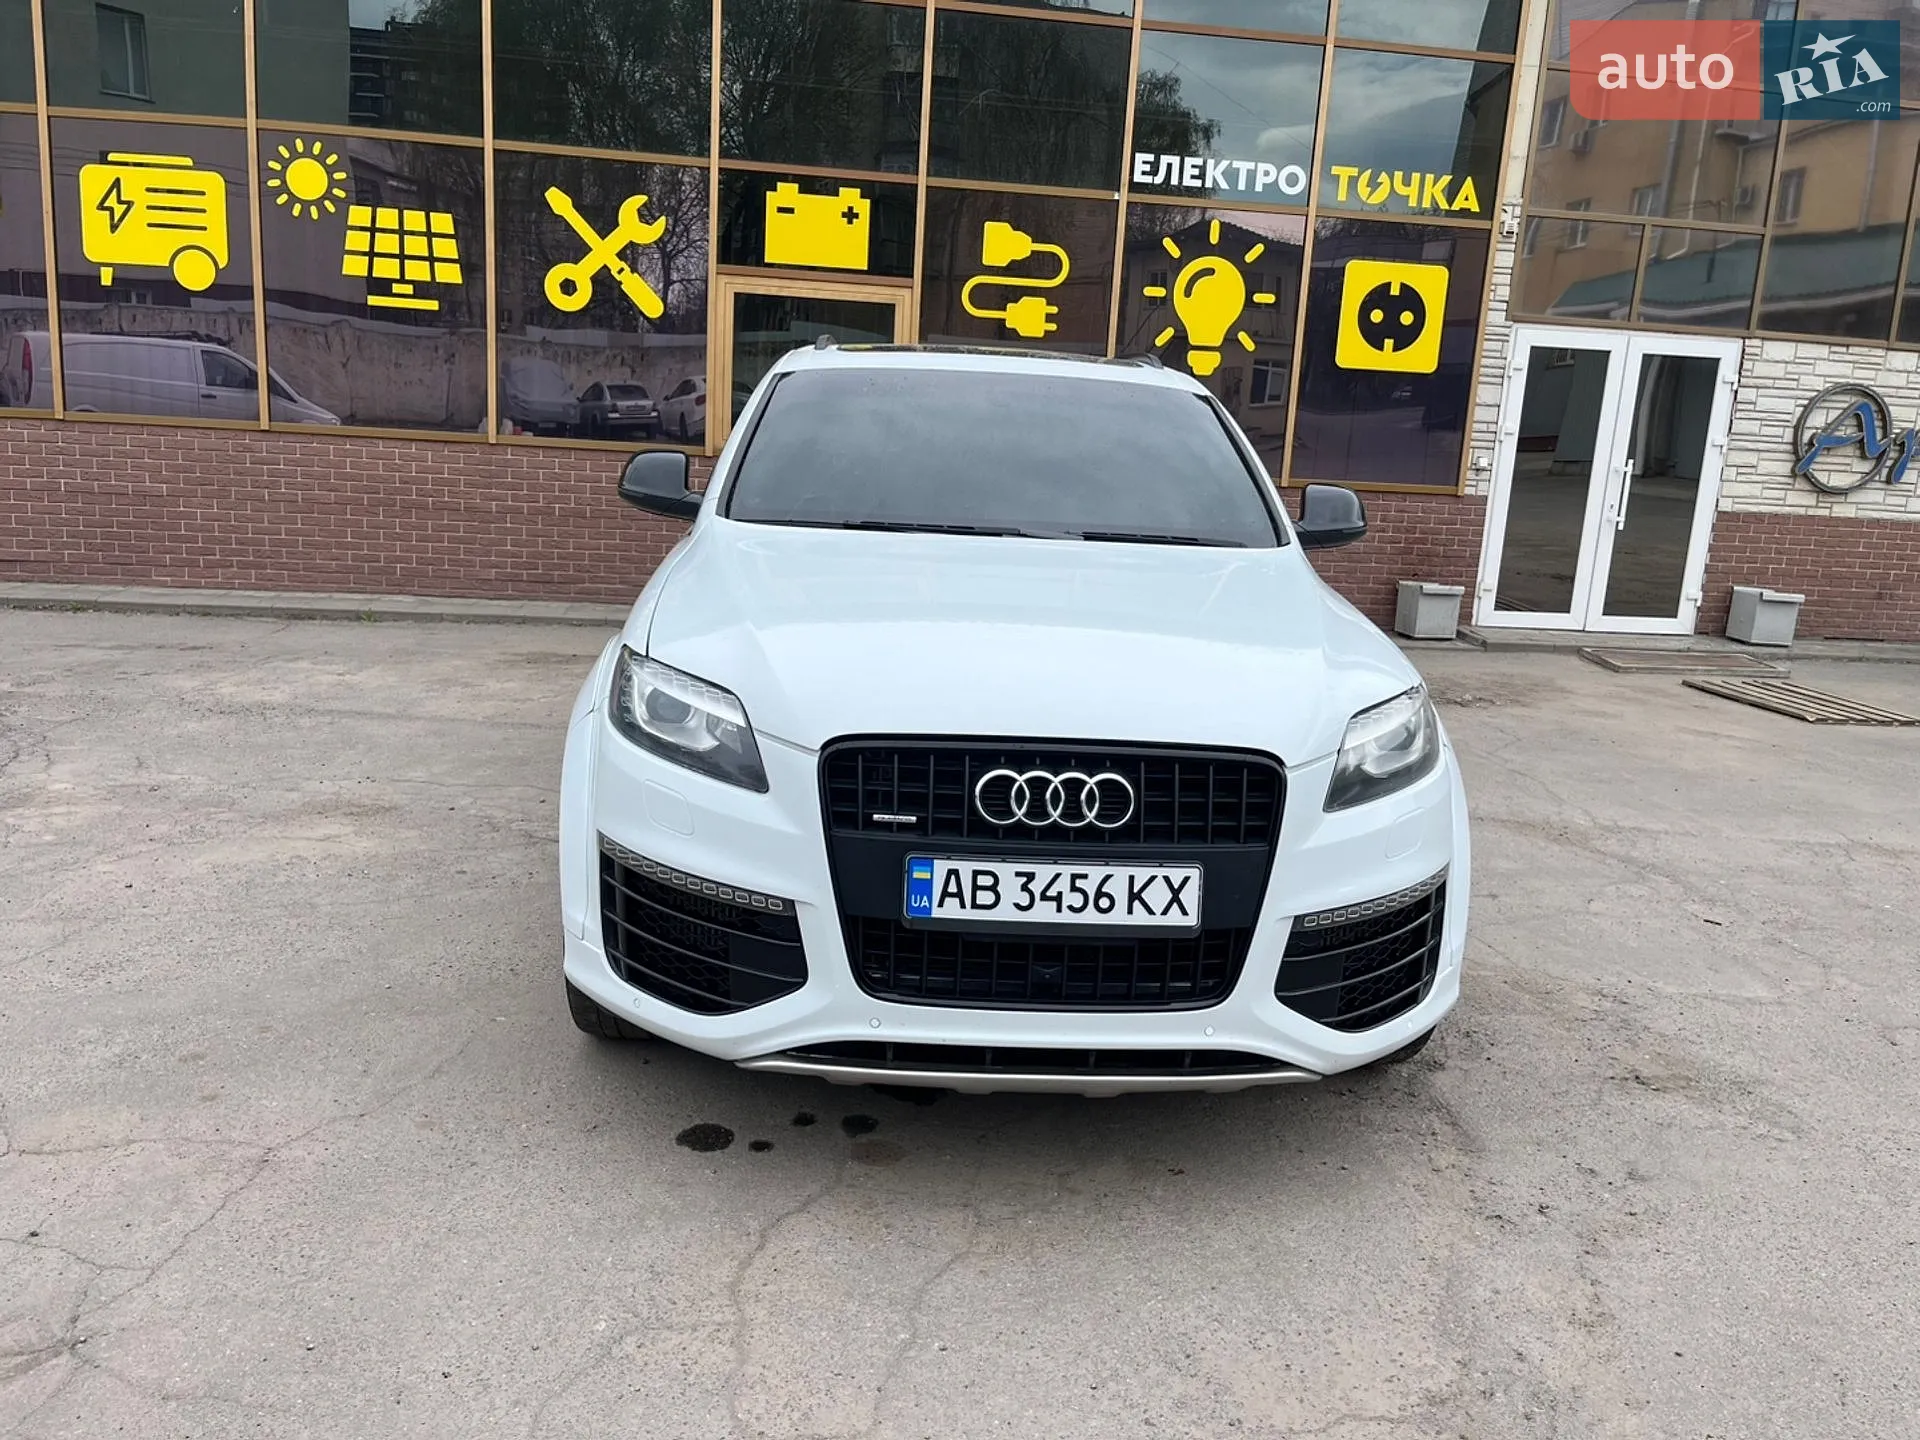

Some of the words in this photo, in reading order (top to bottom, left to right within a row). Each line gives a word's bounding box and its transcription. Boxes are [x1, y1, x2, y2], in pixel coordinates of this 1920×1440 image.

[1132, 152, 1307, 195] ЕЛЕКТРО
[1330, 165, 1481, 213] ТОЧКА
[911, 894, 930, 909] UA
[937, 868, 1002, 911] AB
[1012, 871, 1117, 915] 3456
[1126, 875, 1192, 917] KX
